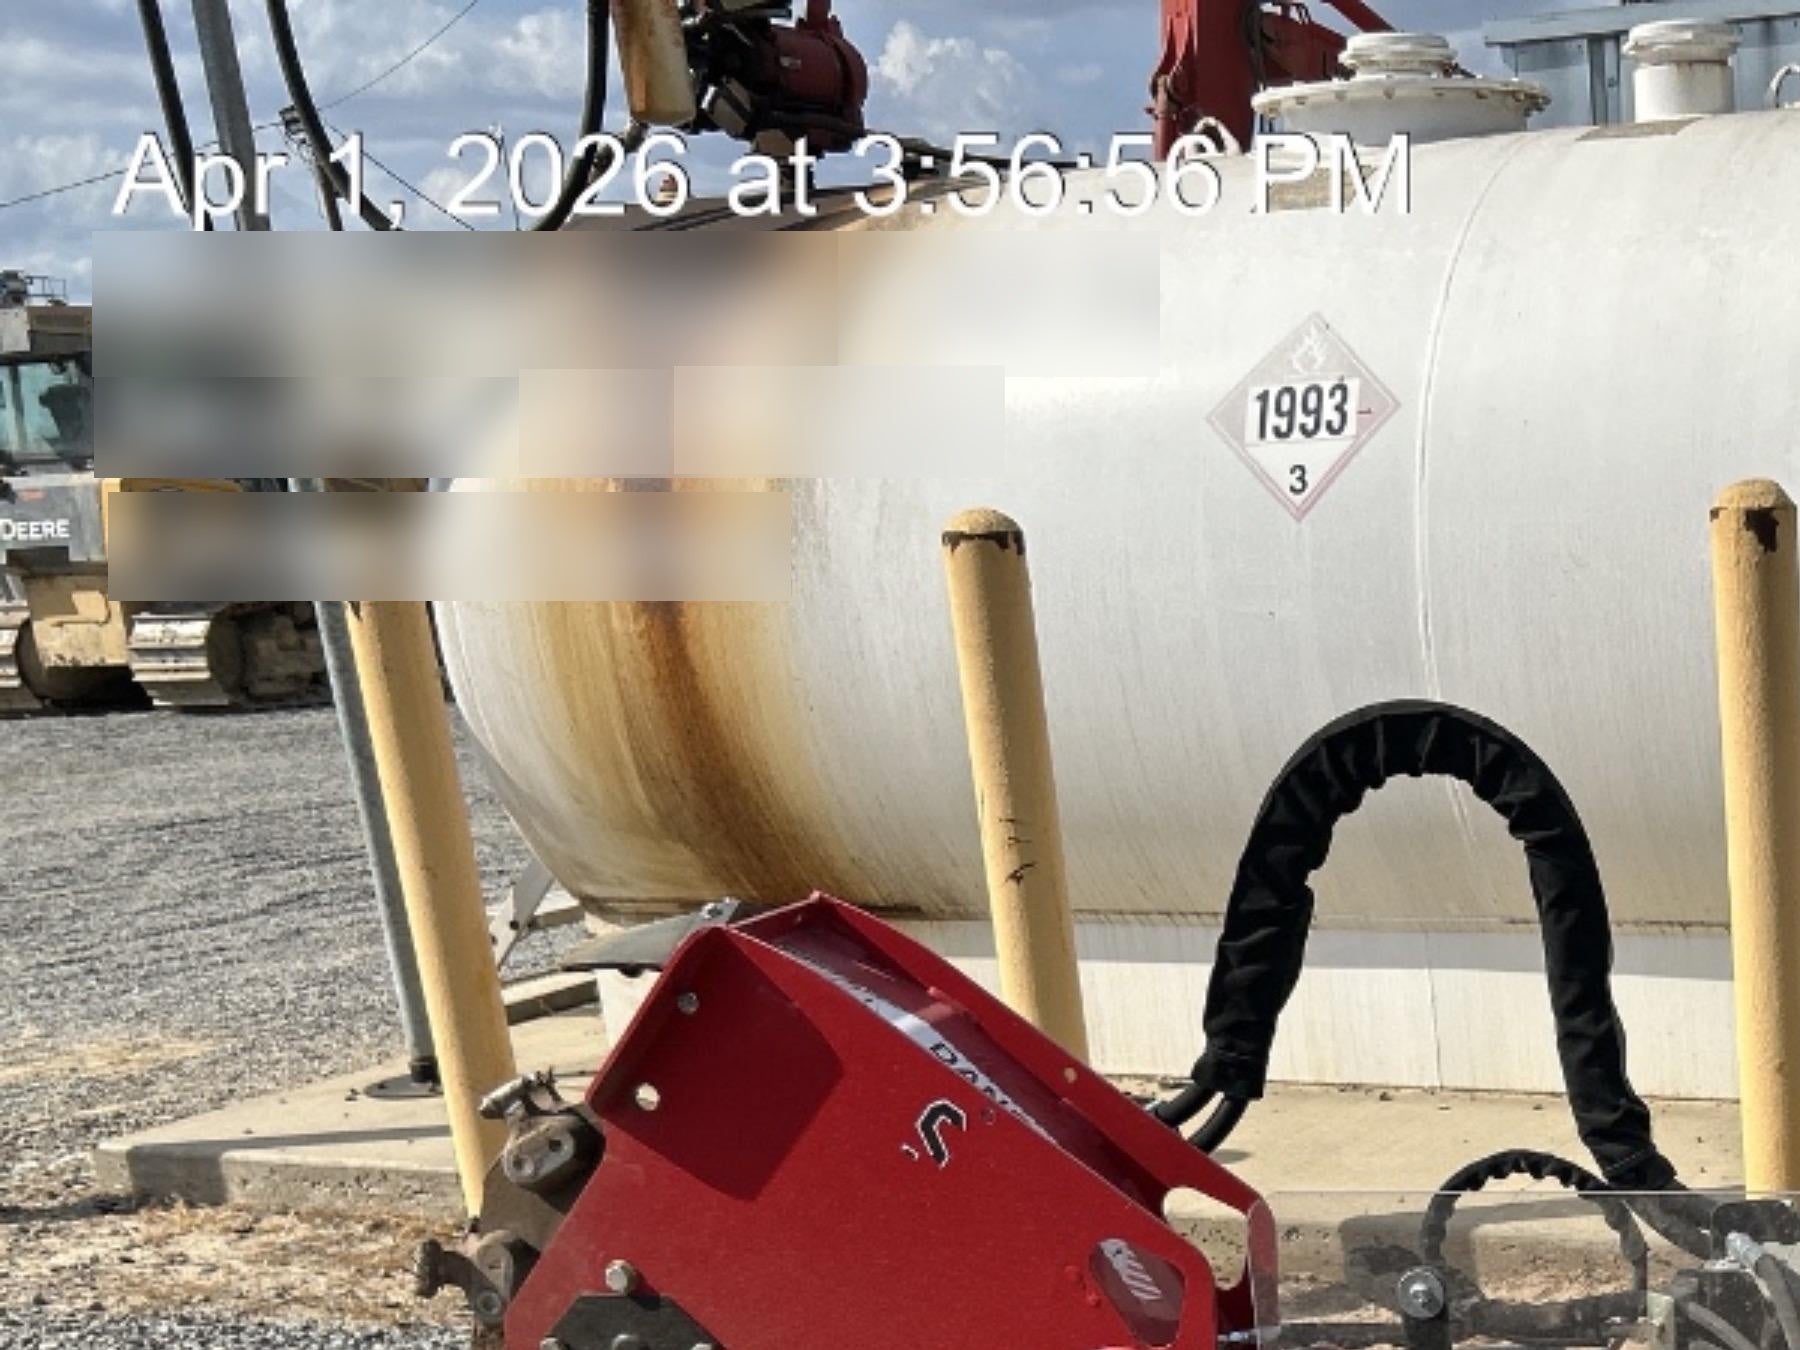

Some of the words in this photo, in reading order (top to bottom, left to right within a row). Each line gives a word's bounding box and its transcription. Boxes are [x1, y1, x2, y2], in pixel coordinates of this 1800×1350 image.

[1254, 382, 1349, 441] 1993
[1289, 464, 1309, 495] 3
[0, 517, 71, 542] DEERE
